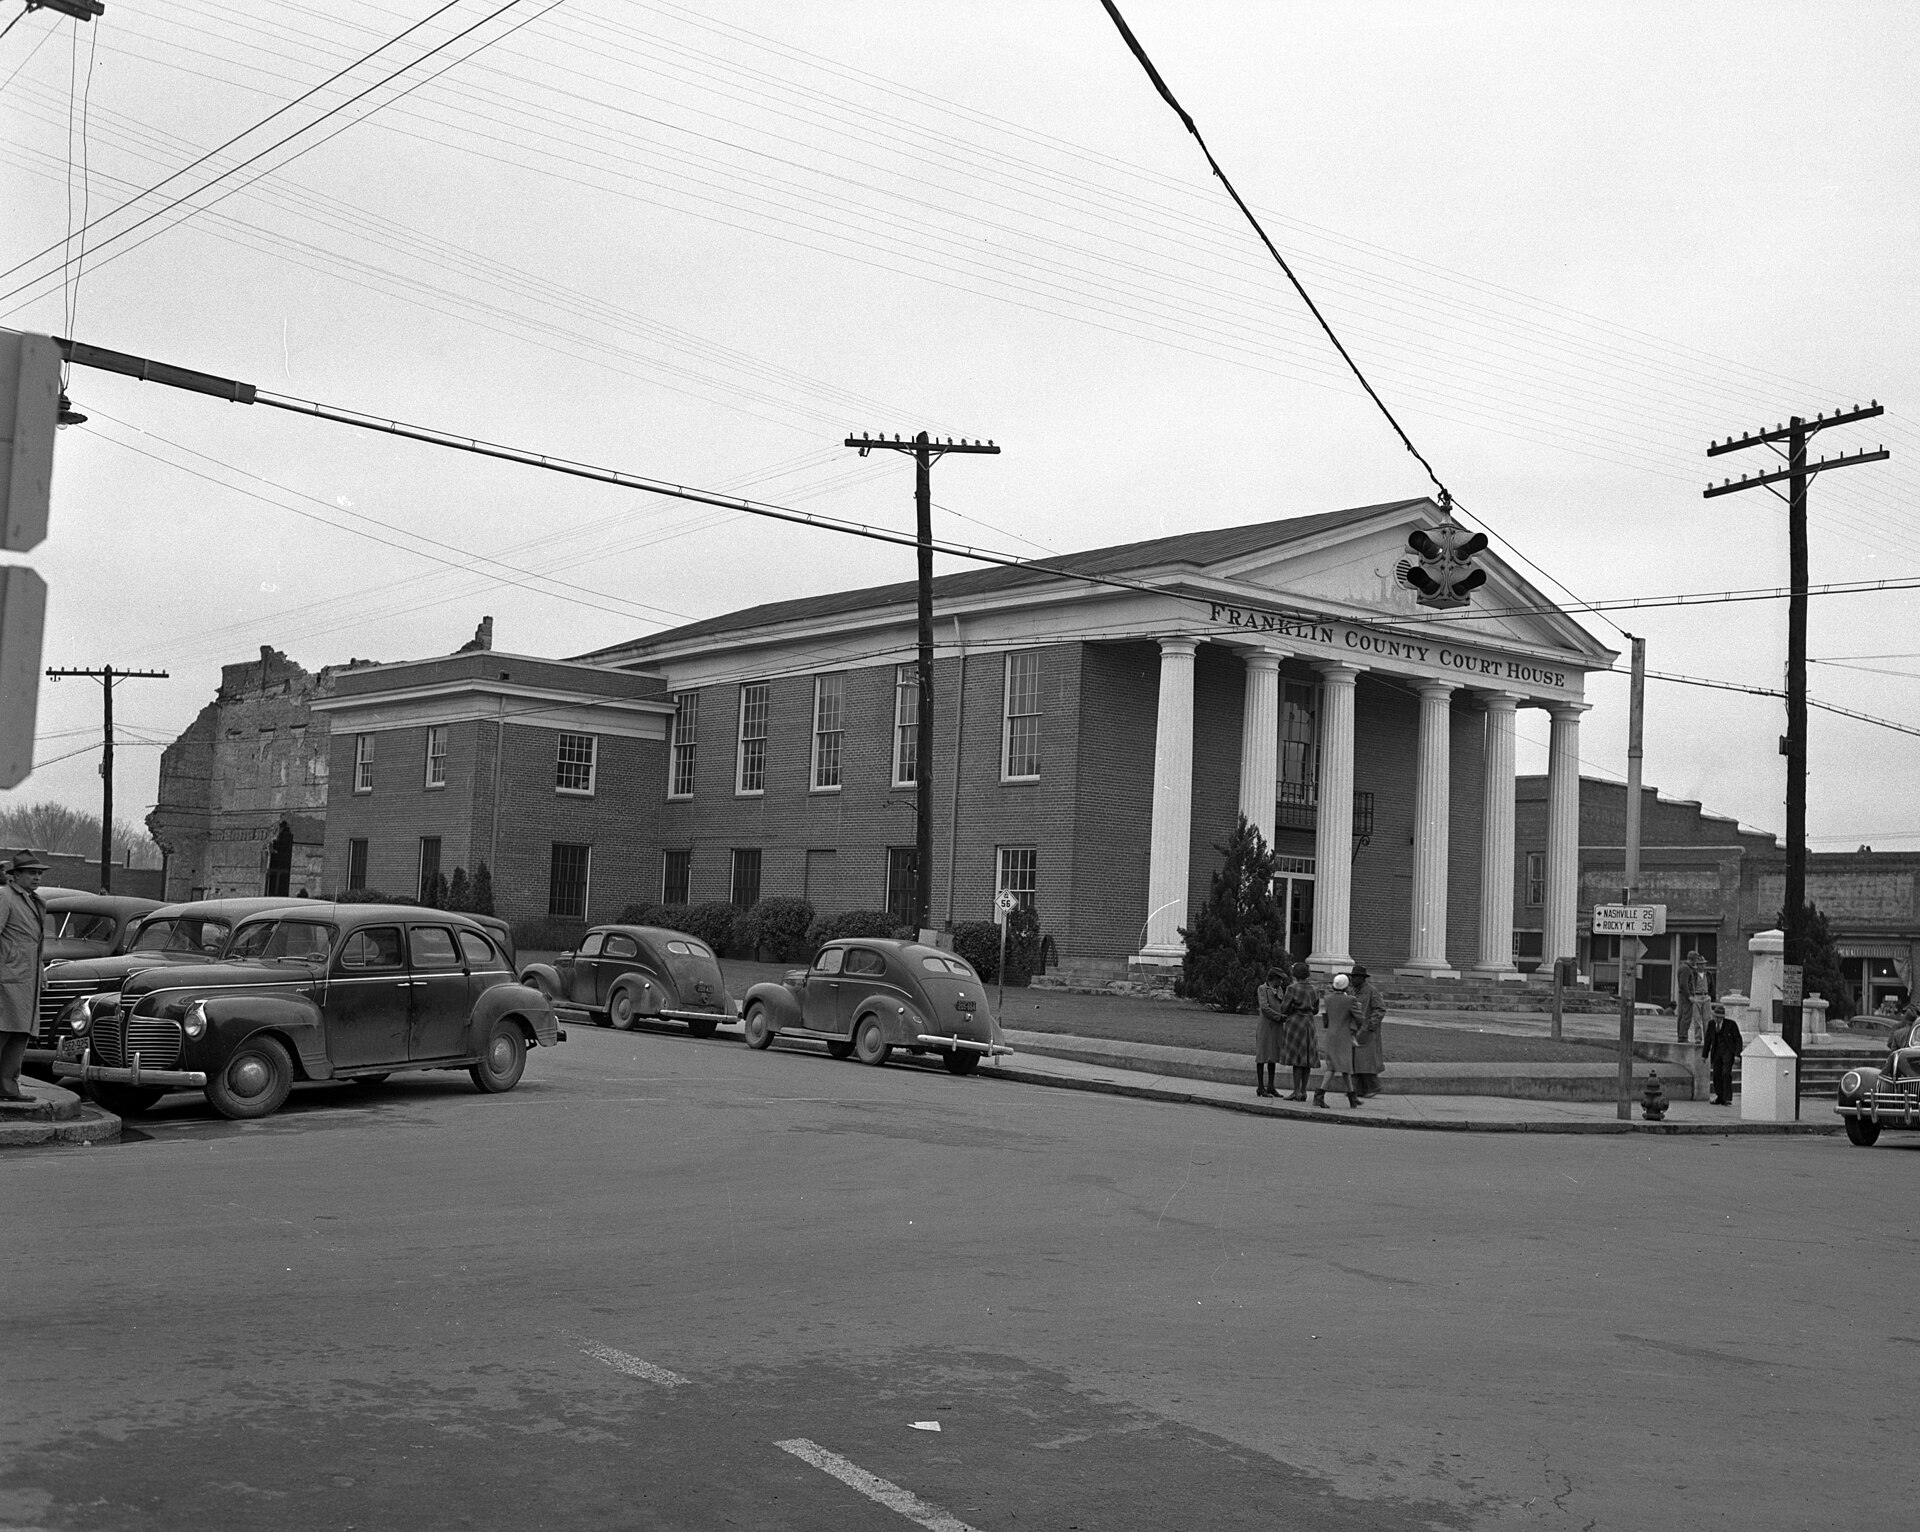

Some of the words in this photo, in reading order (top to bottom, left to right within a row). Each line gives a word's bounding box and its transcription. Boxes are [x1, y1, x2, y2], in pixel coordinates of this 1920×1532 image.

[1210, 602, 1334, 643] FRANKLIN
[1345, 631, 1430, 661] COUNTY
[1440, 649, 1502, 675] COURT
[1506, 662, 1565, 687] HOUSE
[1001, 899, 1011, 908] 56
[1603, 909, 1638, 919] NASHVILLE
[1643, 910, 1653, 919] 25
[1603, 921, 1624, 930] ROCKY
[1641, 922, 1652, 931] 35
